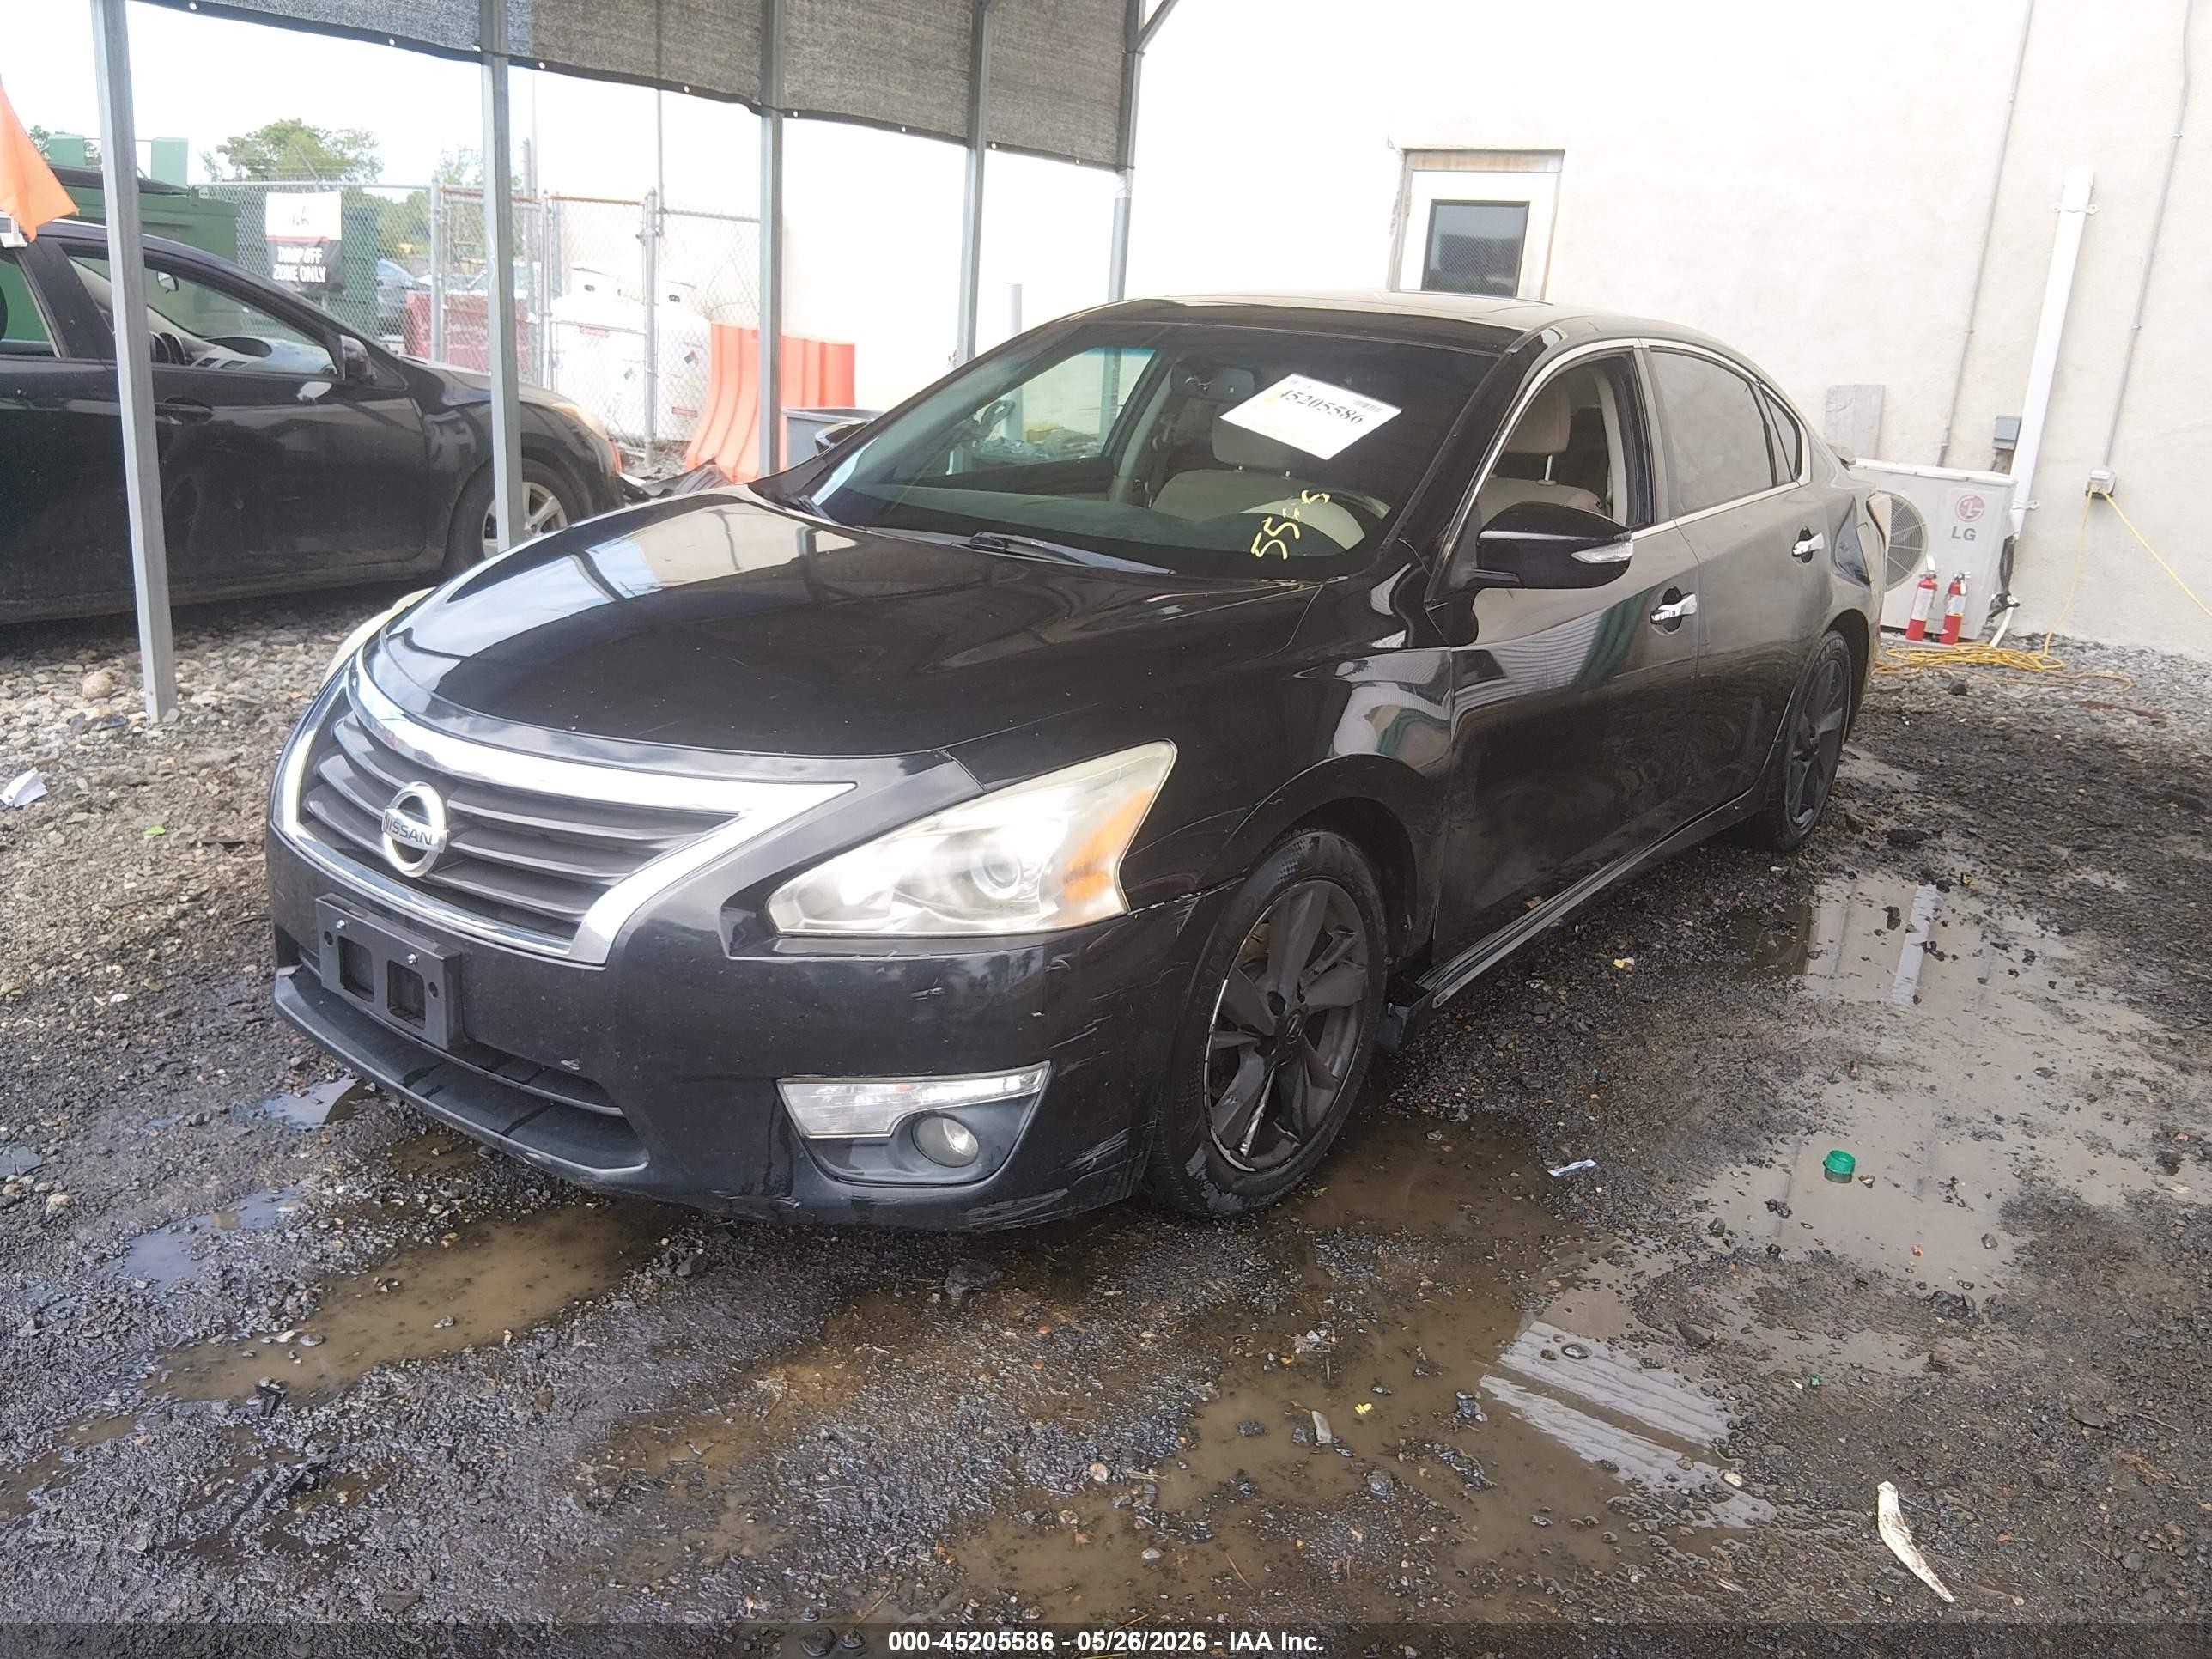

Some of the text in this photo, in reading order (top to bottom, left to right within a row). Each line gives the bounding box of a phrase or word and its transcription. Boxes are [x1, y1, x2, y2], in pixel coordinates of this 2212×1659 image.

[276, 246, 323, 264] DROP OFF
[273, 264, 326, 283] ZONE ONLY
[1951, 526, 1977, 542] LG
[383, 810, 434, 846] NISSAN
